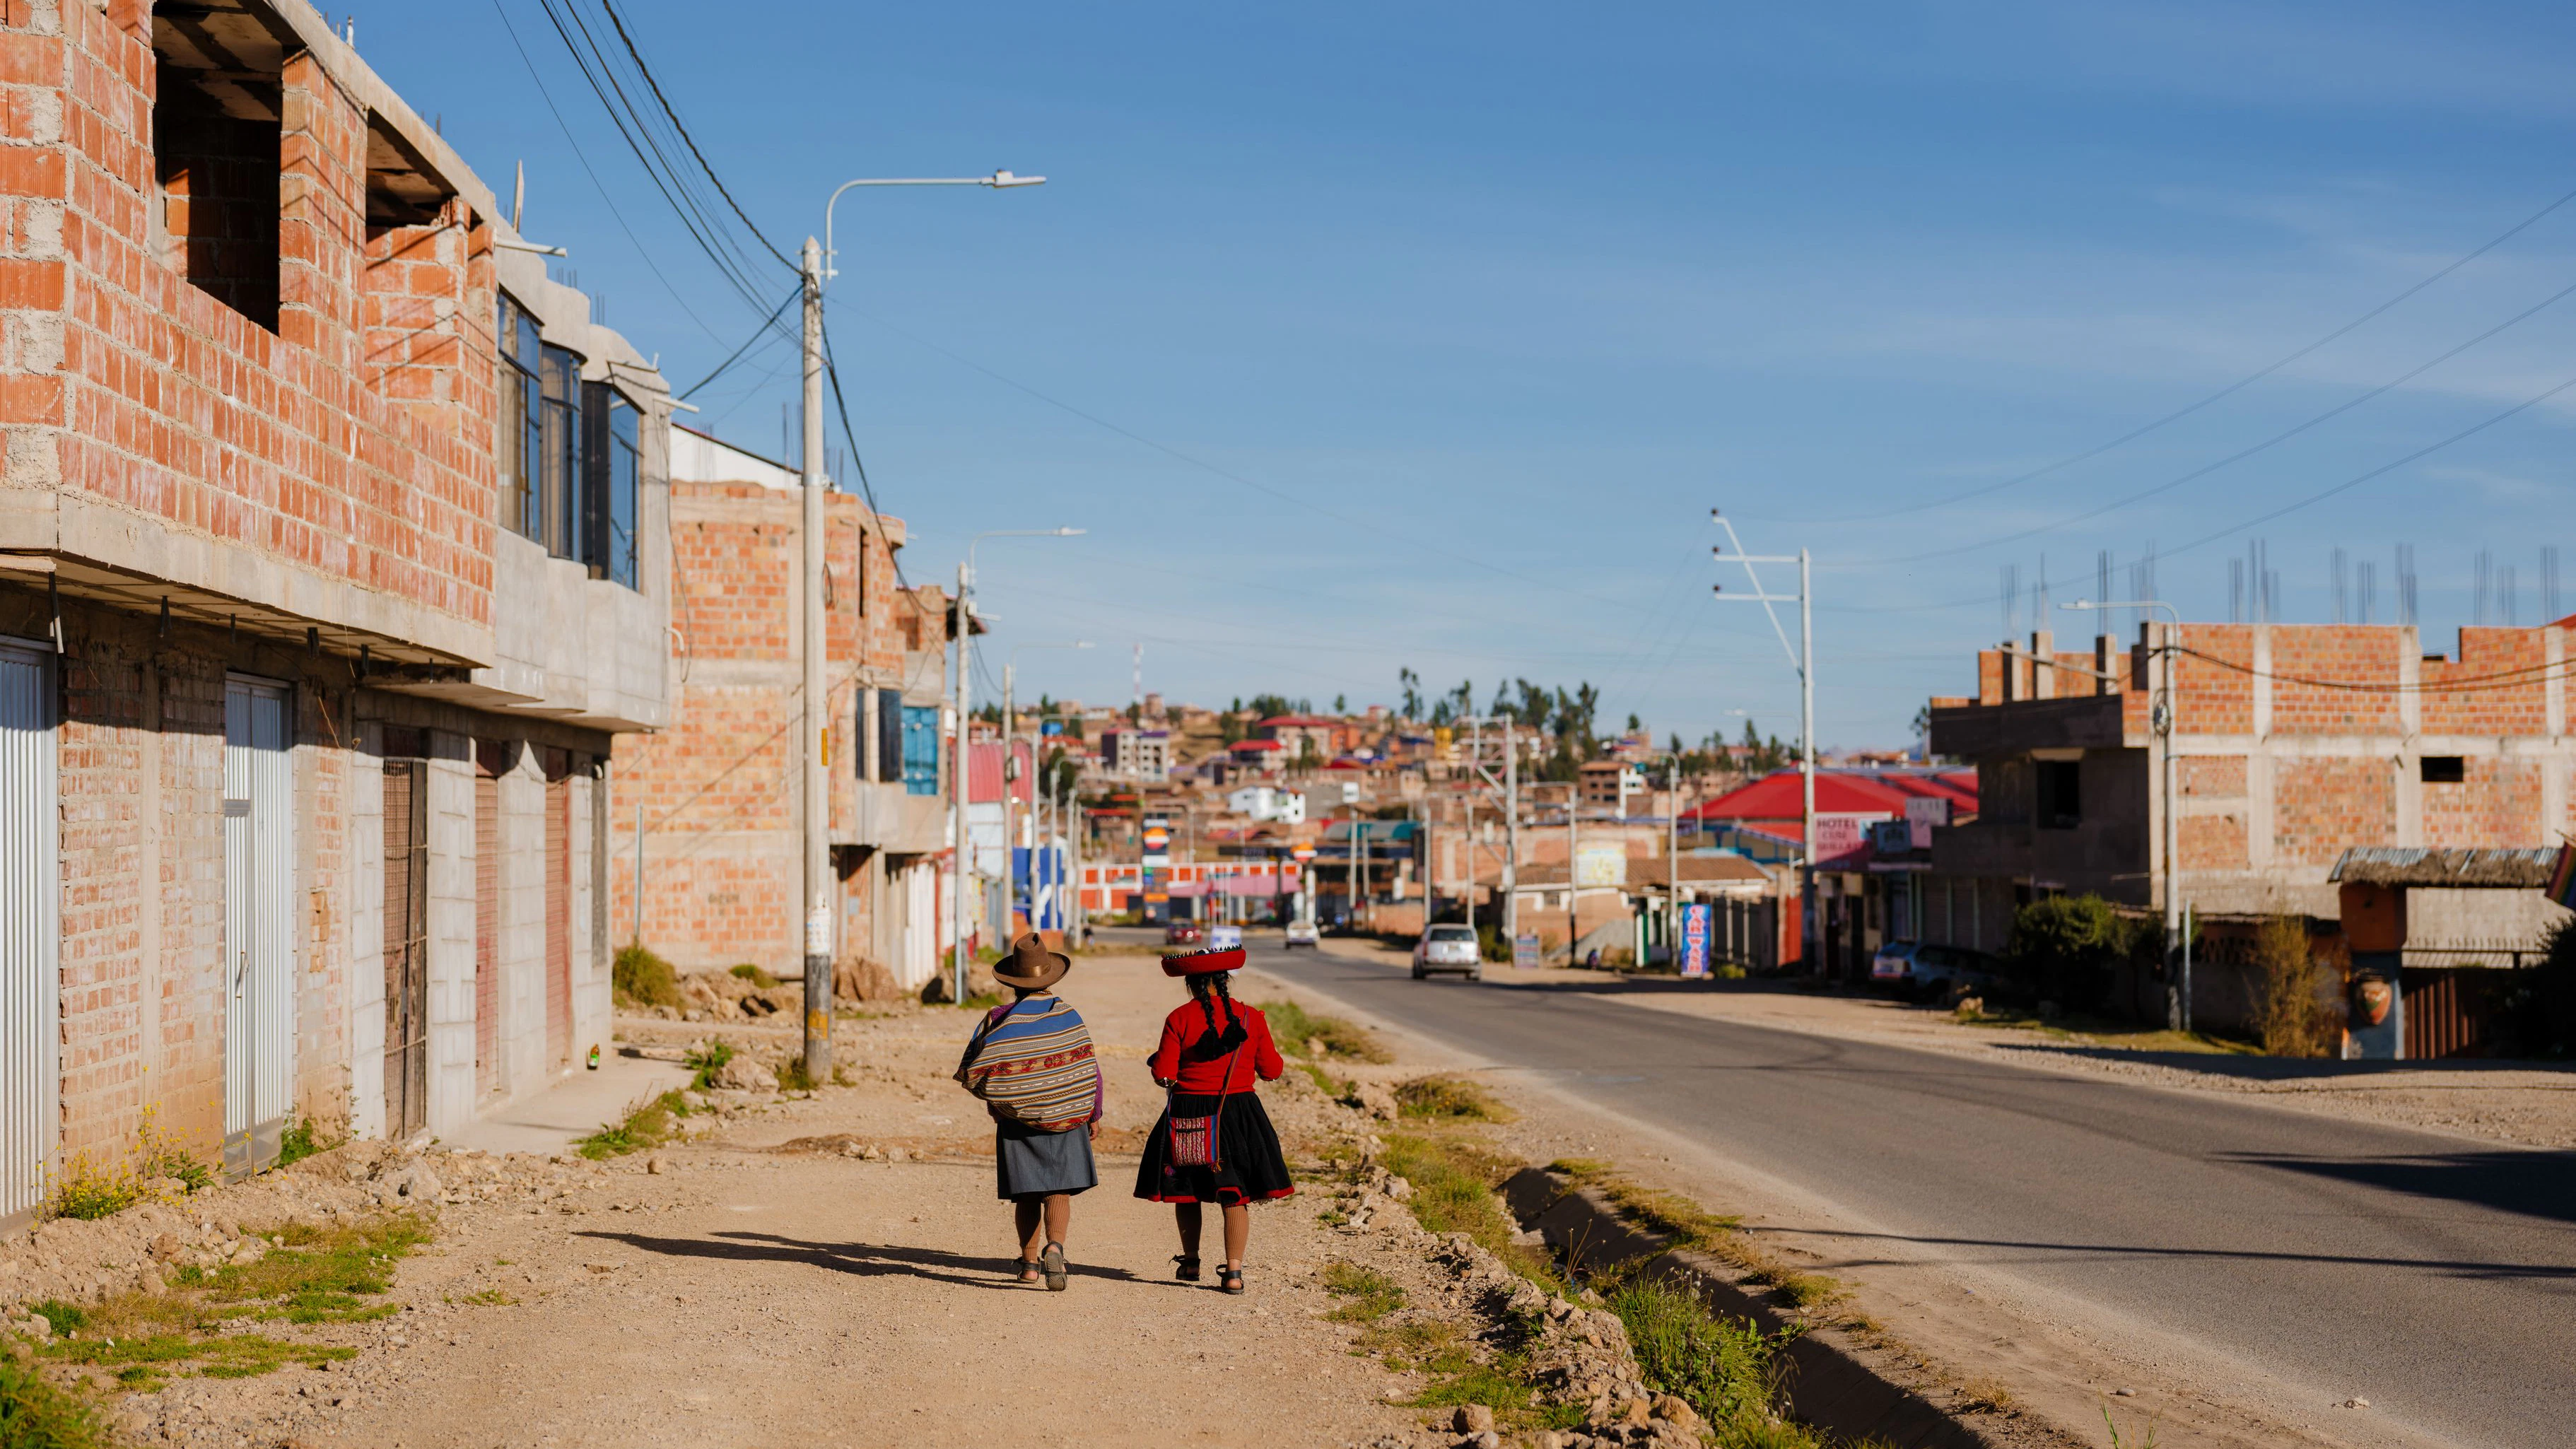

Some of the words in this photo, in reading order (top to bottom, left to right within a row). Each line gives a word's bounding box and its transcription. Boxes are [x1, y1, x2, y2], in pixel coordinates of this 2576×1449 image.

[1816, 818, 1858, 829] HOTEL
[1688, 905, 1704, 934] CAR
[1687, 937, 1704, 973] WASH
